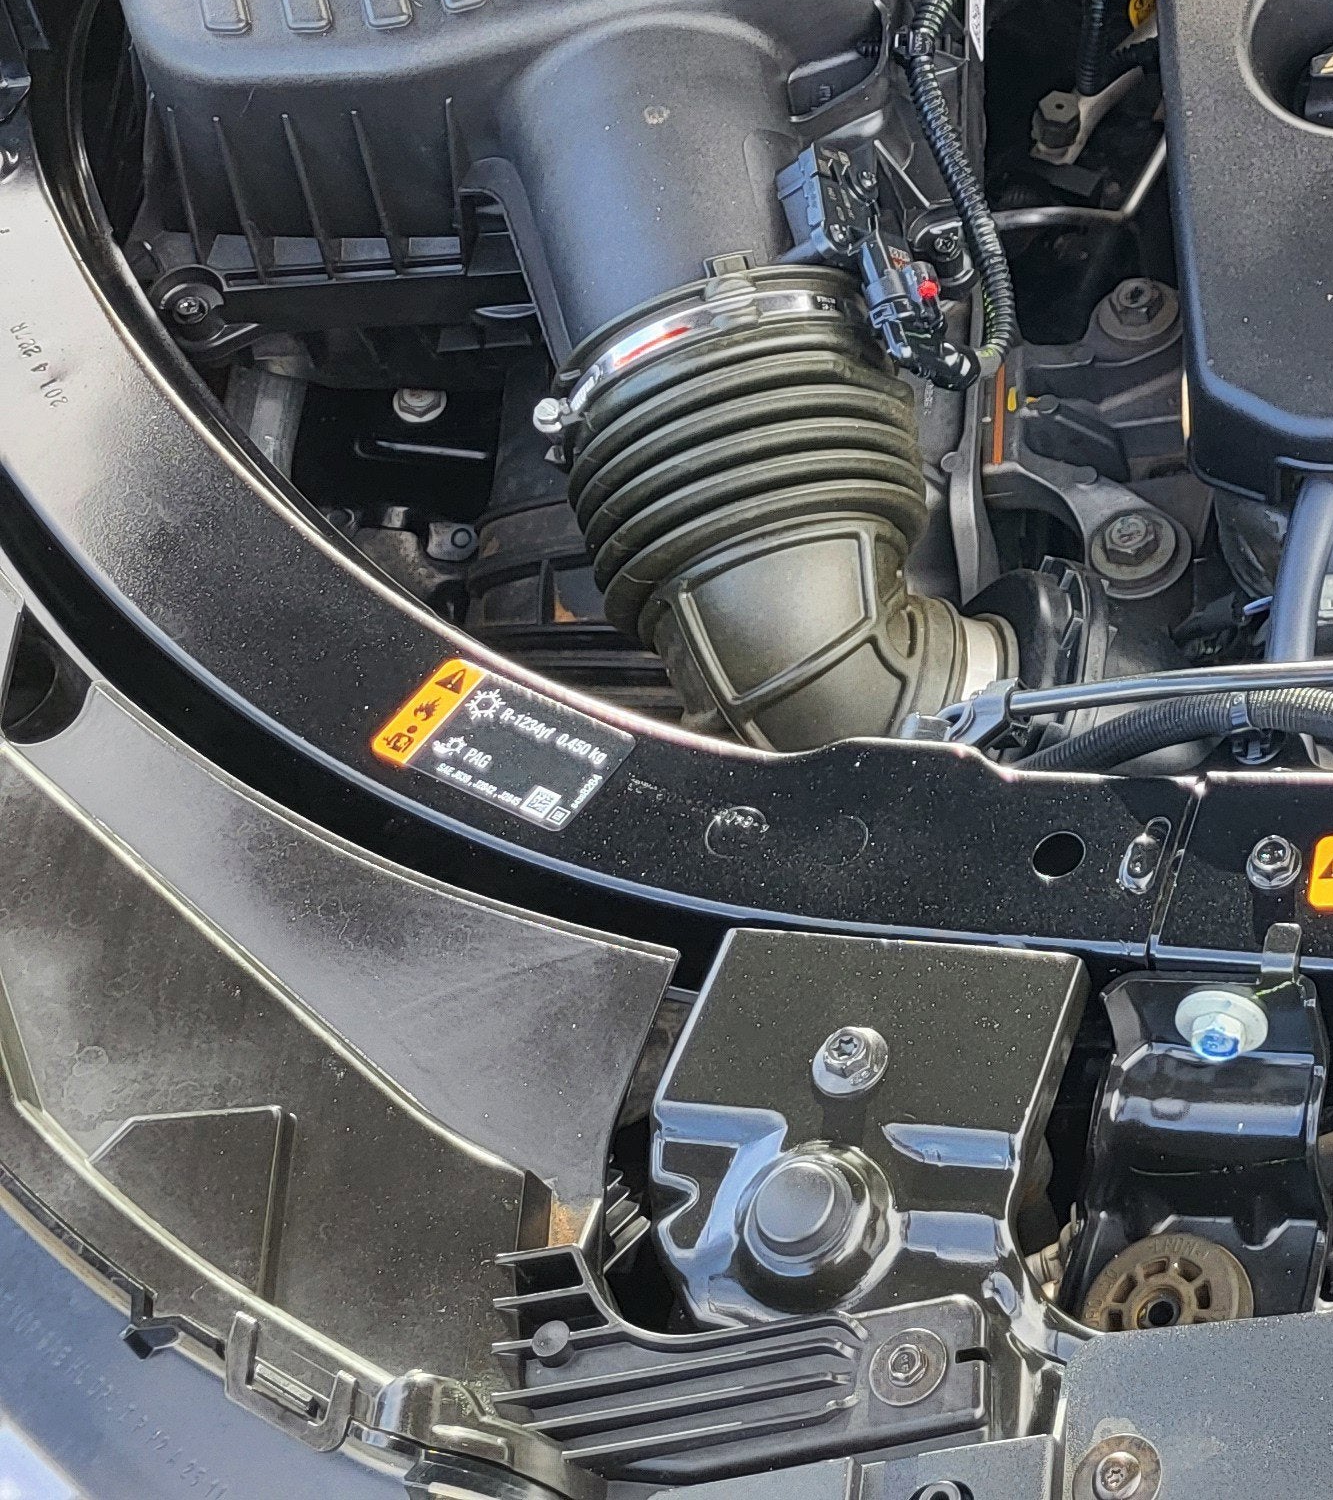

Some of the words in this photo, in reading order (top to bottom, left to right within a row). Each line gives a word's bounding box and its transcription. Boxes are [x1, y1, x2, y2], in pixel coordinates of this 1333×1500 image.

[499, 706, 557, 741] R-1234yf
[556, 731, 592, 758] 0.450
[588, 748, 609, 765] kg
[463, 745, 493, 769] PAG
